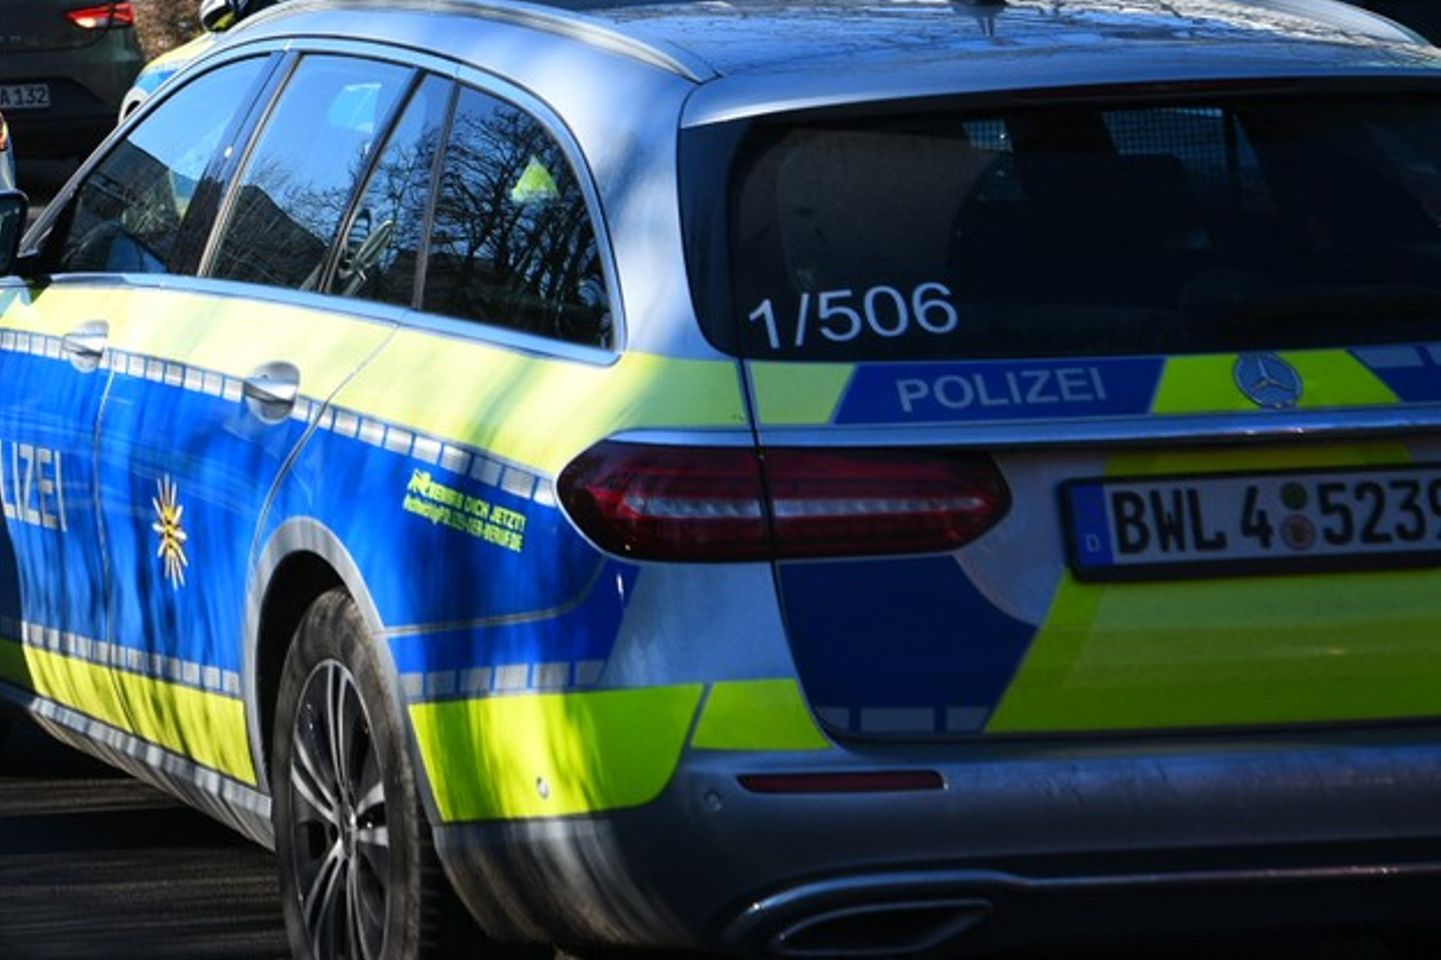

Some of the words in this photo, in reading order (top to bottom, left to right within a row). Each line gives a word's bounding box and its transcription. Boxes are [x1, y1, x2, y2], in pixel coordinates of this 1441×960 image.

[14, 87, 48, 105] 132
[747, 281, 959, 350] 1/506
[894, 366, 1110, 413] POLIZEI
[1111, 487, 1228, 555] BWL
[1241, 485, 1274, 549] 4
